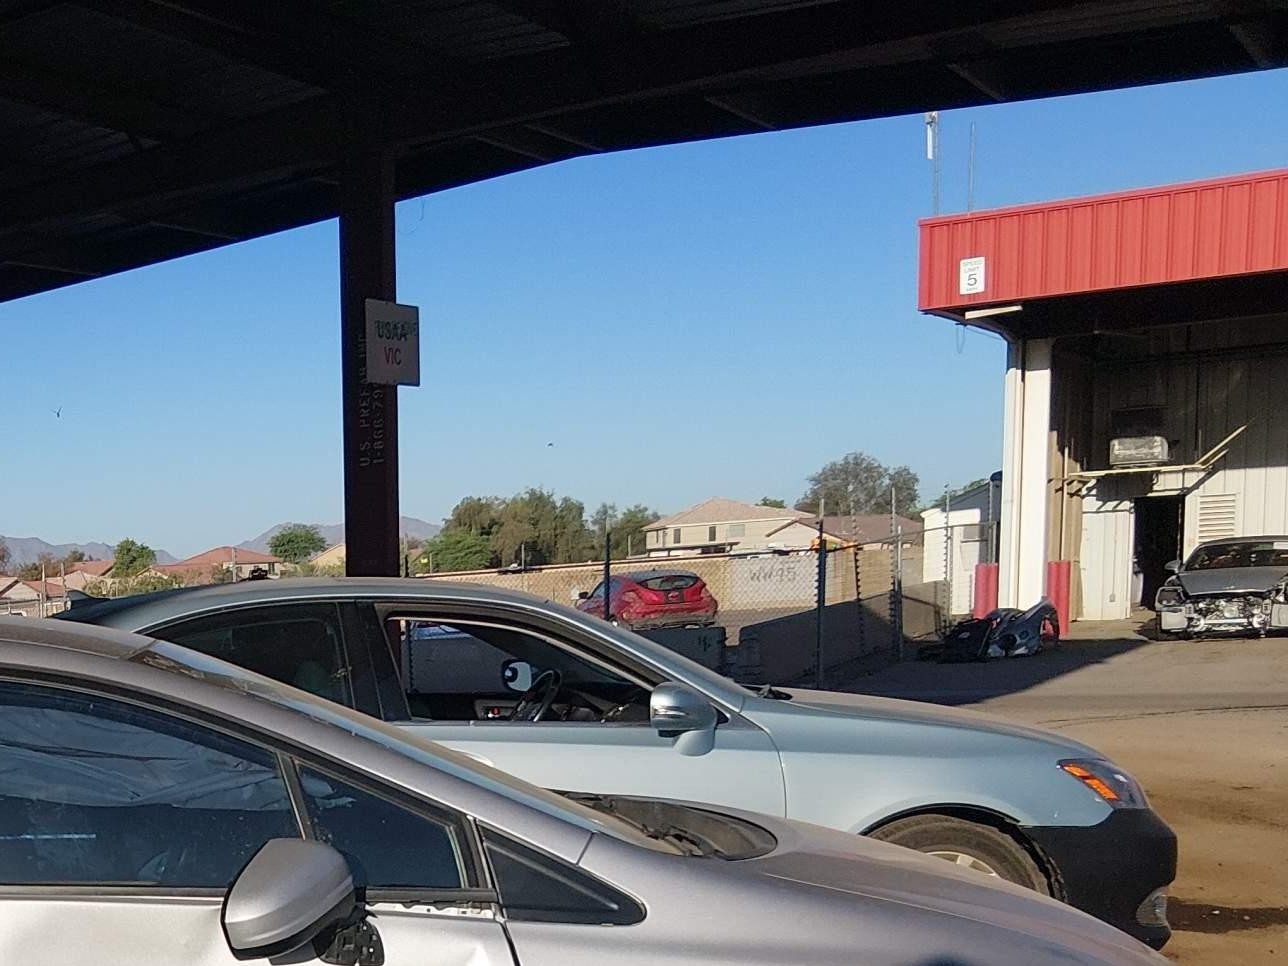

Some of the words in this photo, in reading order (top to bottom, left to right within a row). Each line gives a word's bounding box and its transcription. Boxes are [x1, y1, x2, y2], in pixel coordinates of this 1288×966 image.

[967, 273, 978, 286] 5
[377, 320, 408, 342] USAA
[384, 345, 402, 365] VIC
